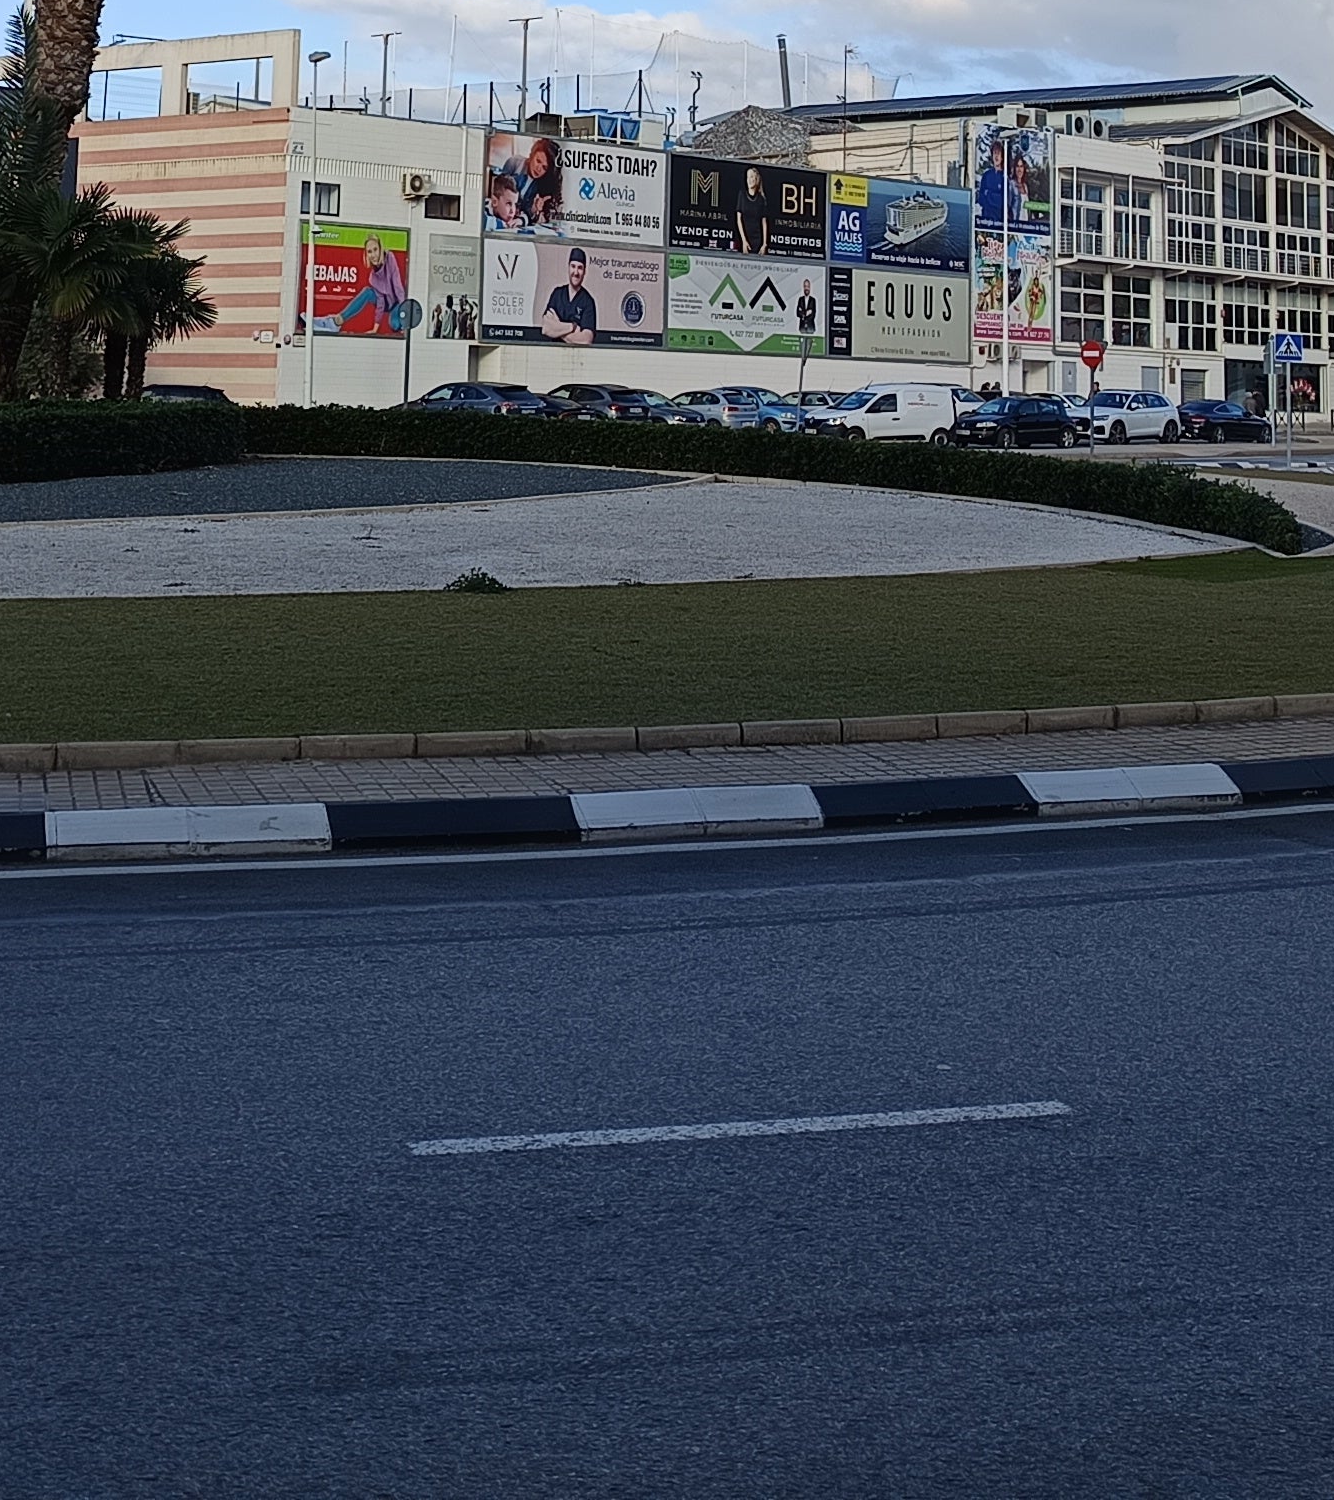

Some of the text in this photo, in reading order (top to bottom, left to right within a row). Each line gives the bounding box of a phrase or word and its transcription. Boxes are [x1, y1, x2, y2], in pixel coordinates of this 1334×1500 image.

[556, 148, 658, 178] ¿SUFRES TDAH?
[596, 182, 636, 202] Alevia
[781, 182, 817, 217] BH
[837, 210, 861, 232] AG
[675, 225, 733, 239] VENDE CON
[834, 230, 863, 244] VIAJES
[770, 234, 822, 248] NOSOTROS
[433, 265, 475, 276] SOMOS TU
[589, 256, 610, 268] Mejor
[611, 257, 660, 272] traumatólogo
[442, 274, 465, 285] CLUB
[603, 270, 659, 282] de Europa 2023
[491, 295, 524, 307] SOLER
[866, 280, 953, 322] EQUUS
[492, 306, 524, 316] VALERO
